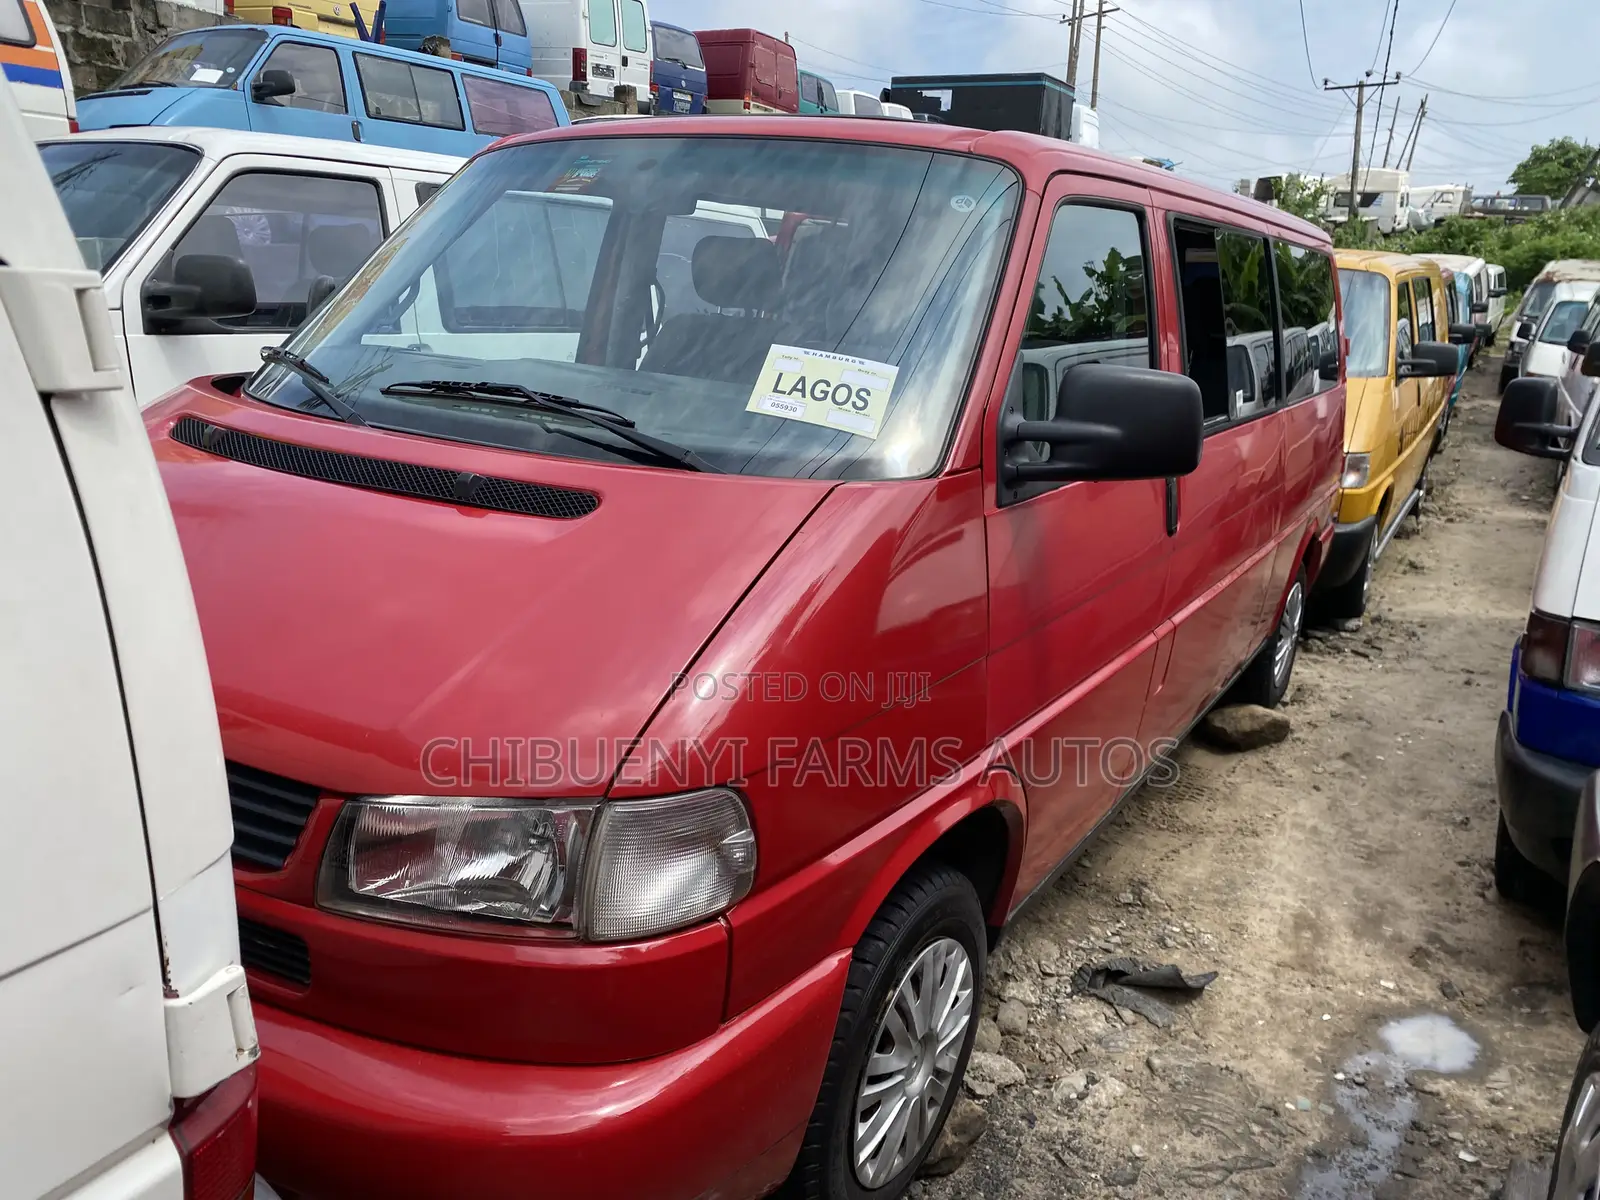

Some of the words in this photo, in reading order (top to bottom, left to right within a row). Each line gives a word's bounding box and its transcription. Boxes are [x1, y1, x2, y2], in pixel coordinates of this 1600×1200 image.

[812, 352, 857, 363] HAMBURG
[772, 372, 872, 412] LAGOS
[770, 401, 798, 413] 055930
